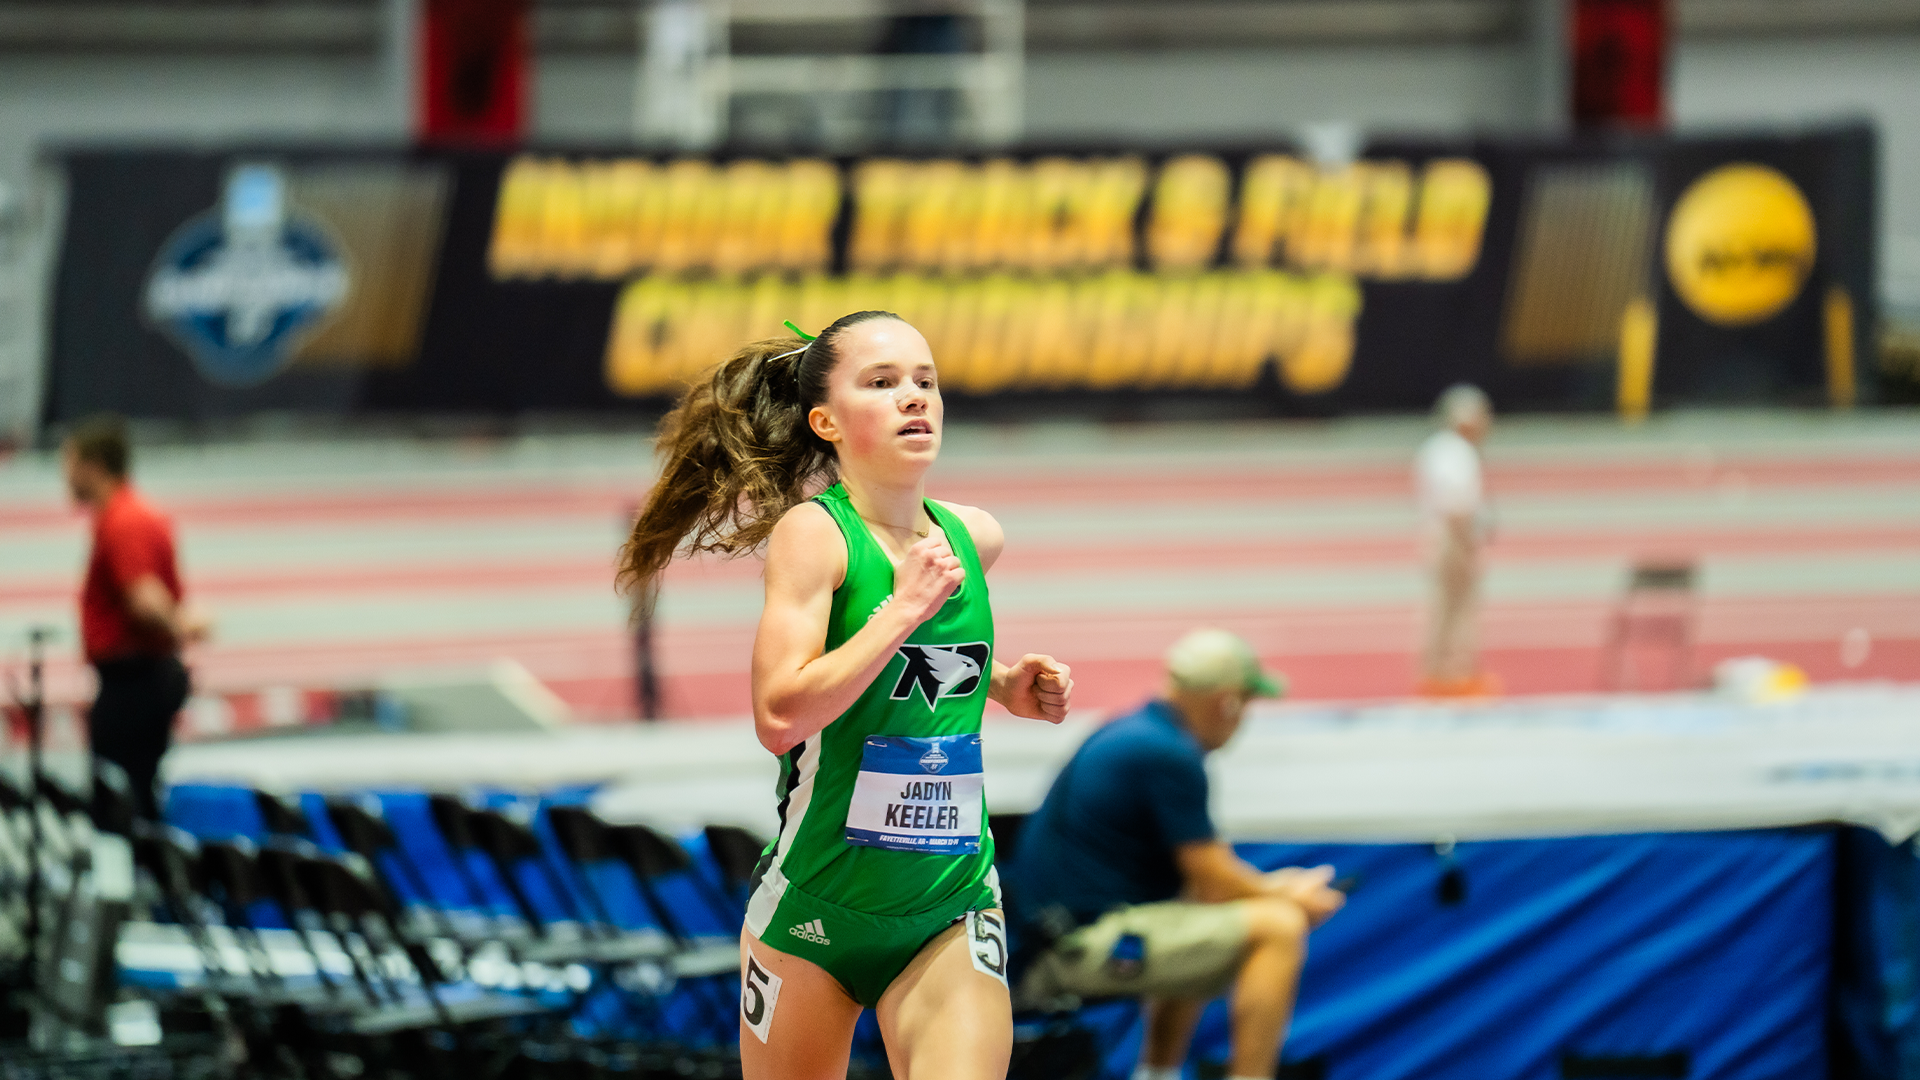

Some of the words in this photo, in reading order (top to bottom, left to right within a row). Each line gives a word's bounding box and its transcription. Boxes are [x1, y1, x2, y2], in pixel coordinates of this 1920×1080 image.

[847, 155, 1149, 272] TRACK
[1232, 156, 1491, 280] FIELD
[900, 781, 952, 801] JADYN
[885, 804, 959, 830] KEELER
[929, 838, 947, 846] MARCH
[789, 926, 831, 946] adidas
[974, 911, 1004, 977] 5
[743, 956, 770, 1026] 5
